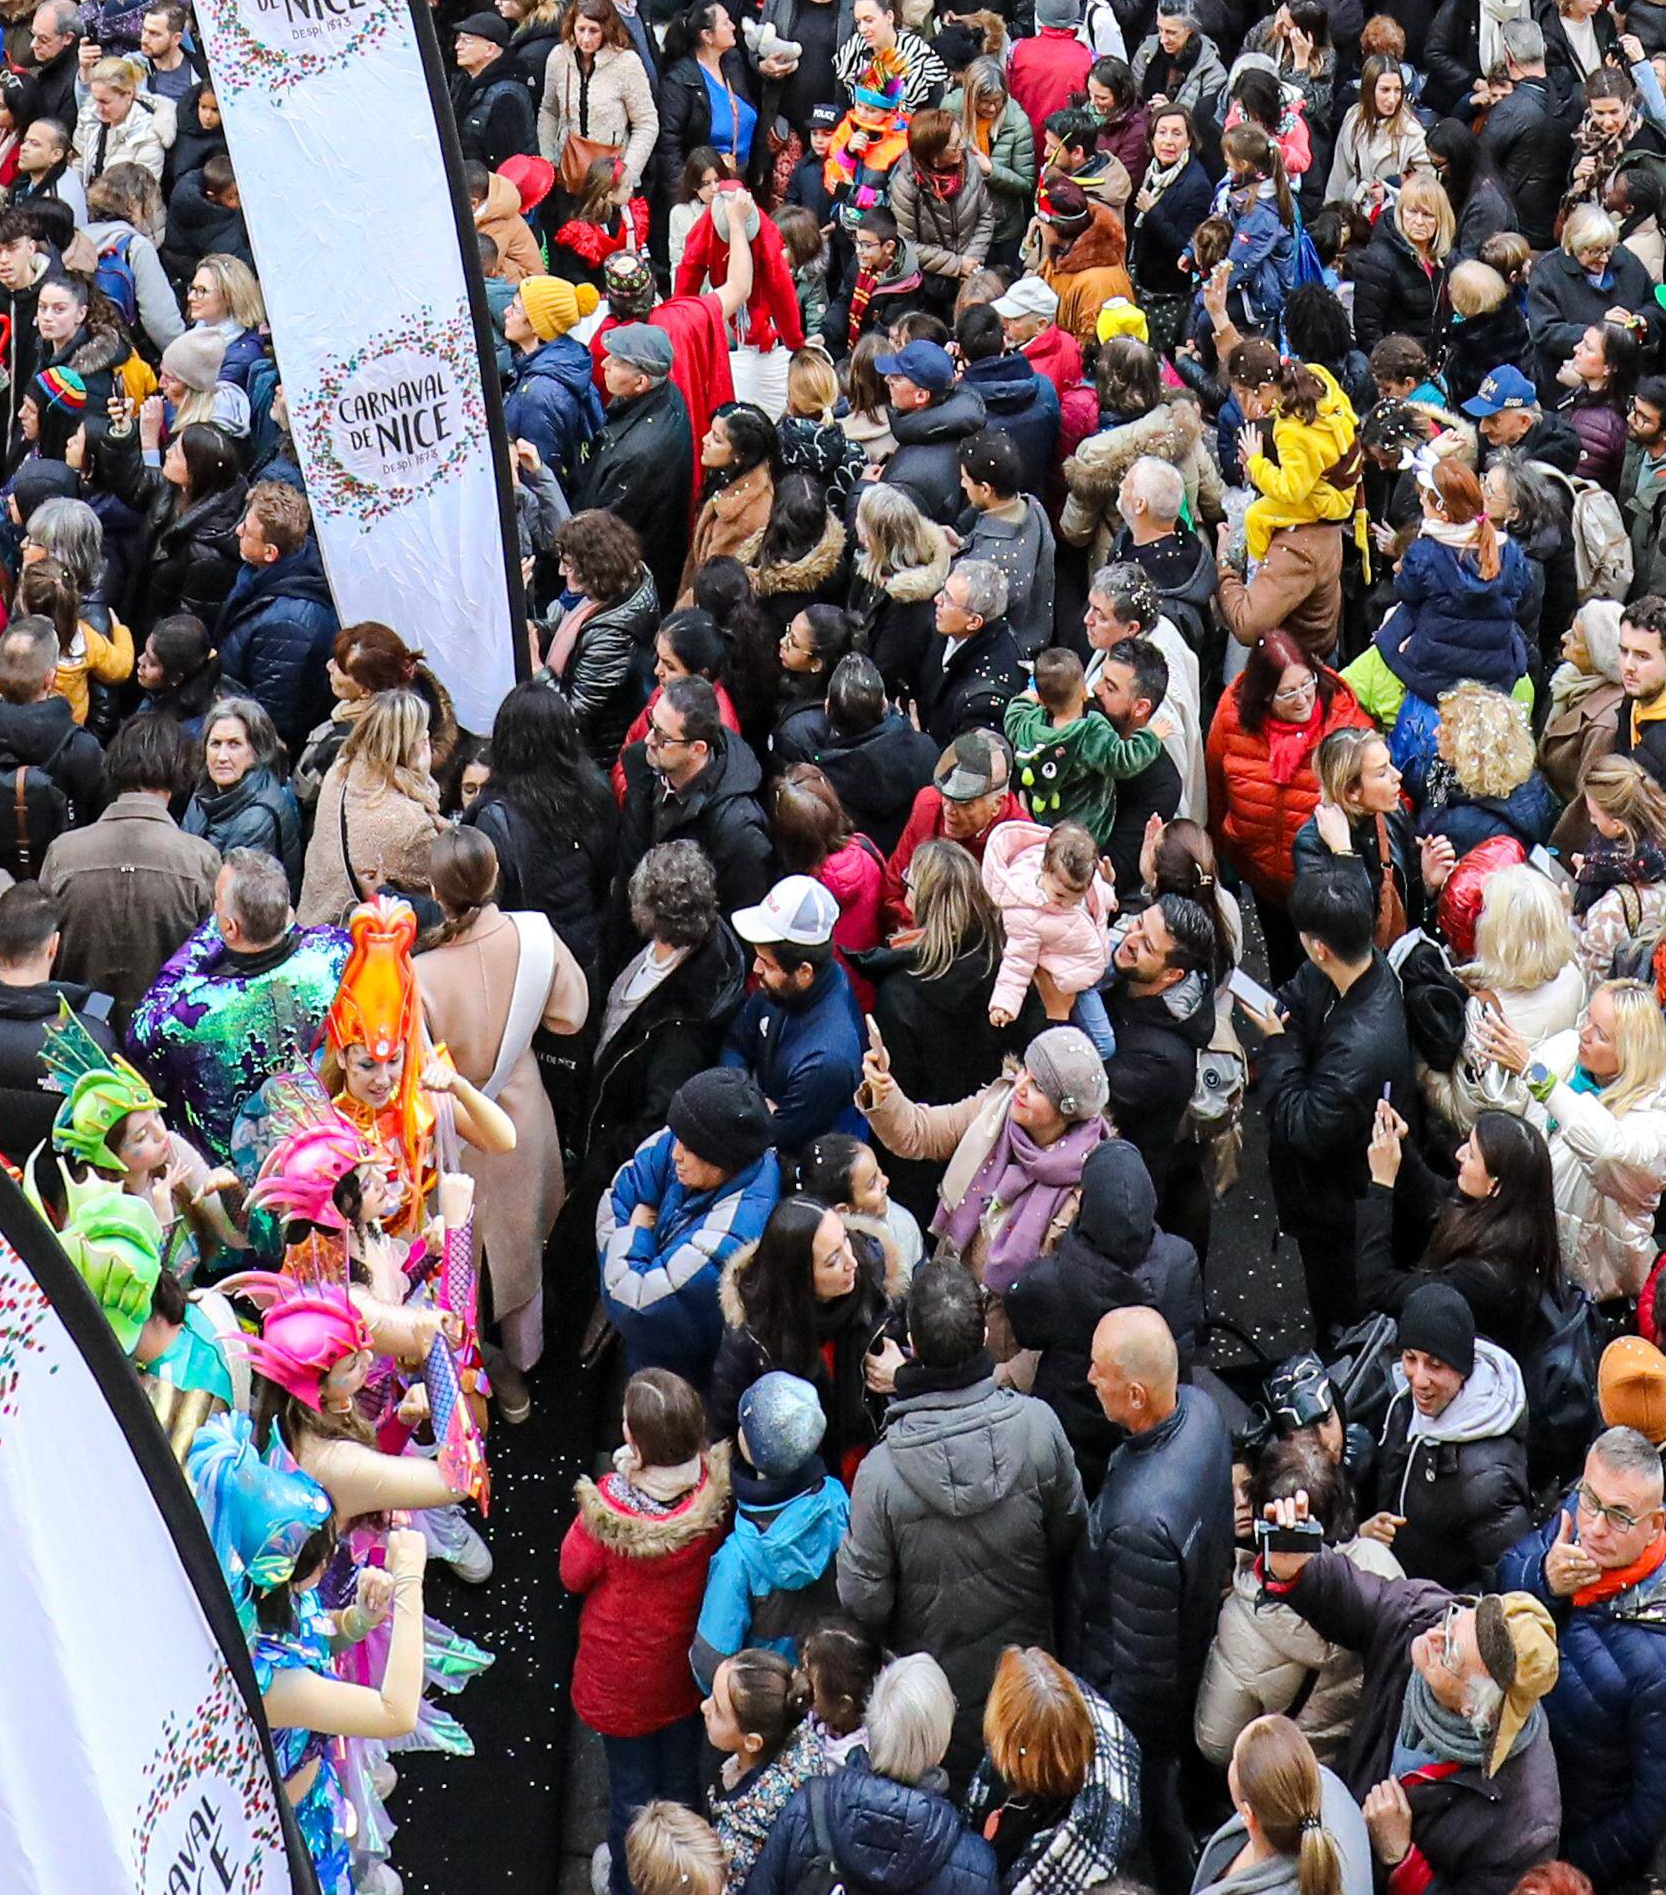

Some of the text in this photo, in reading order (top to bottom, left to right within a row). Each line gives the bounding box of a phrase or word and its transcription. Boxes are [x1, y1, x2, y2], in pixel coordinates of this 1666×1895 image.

[338, 371, 450, 424] CARNAVAL
[349, 401, 453, 458] DE NICE
